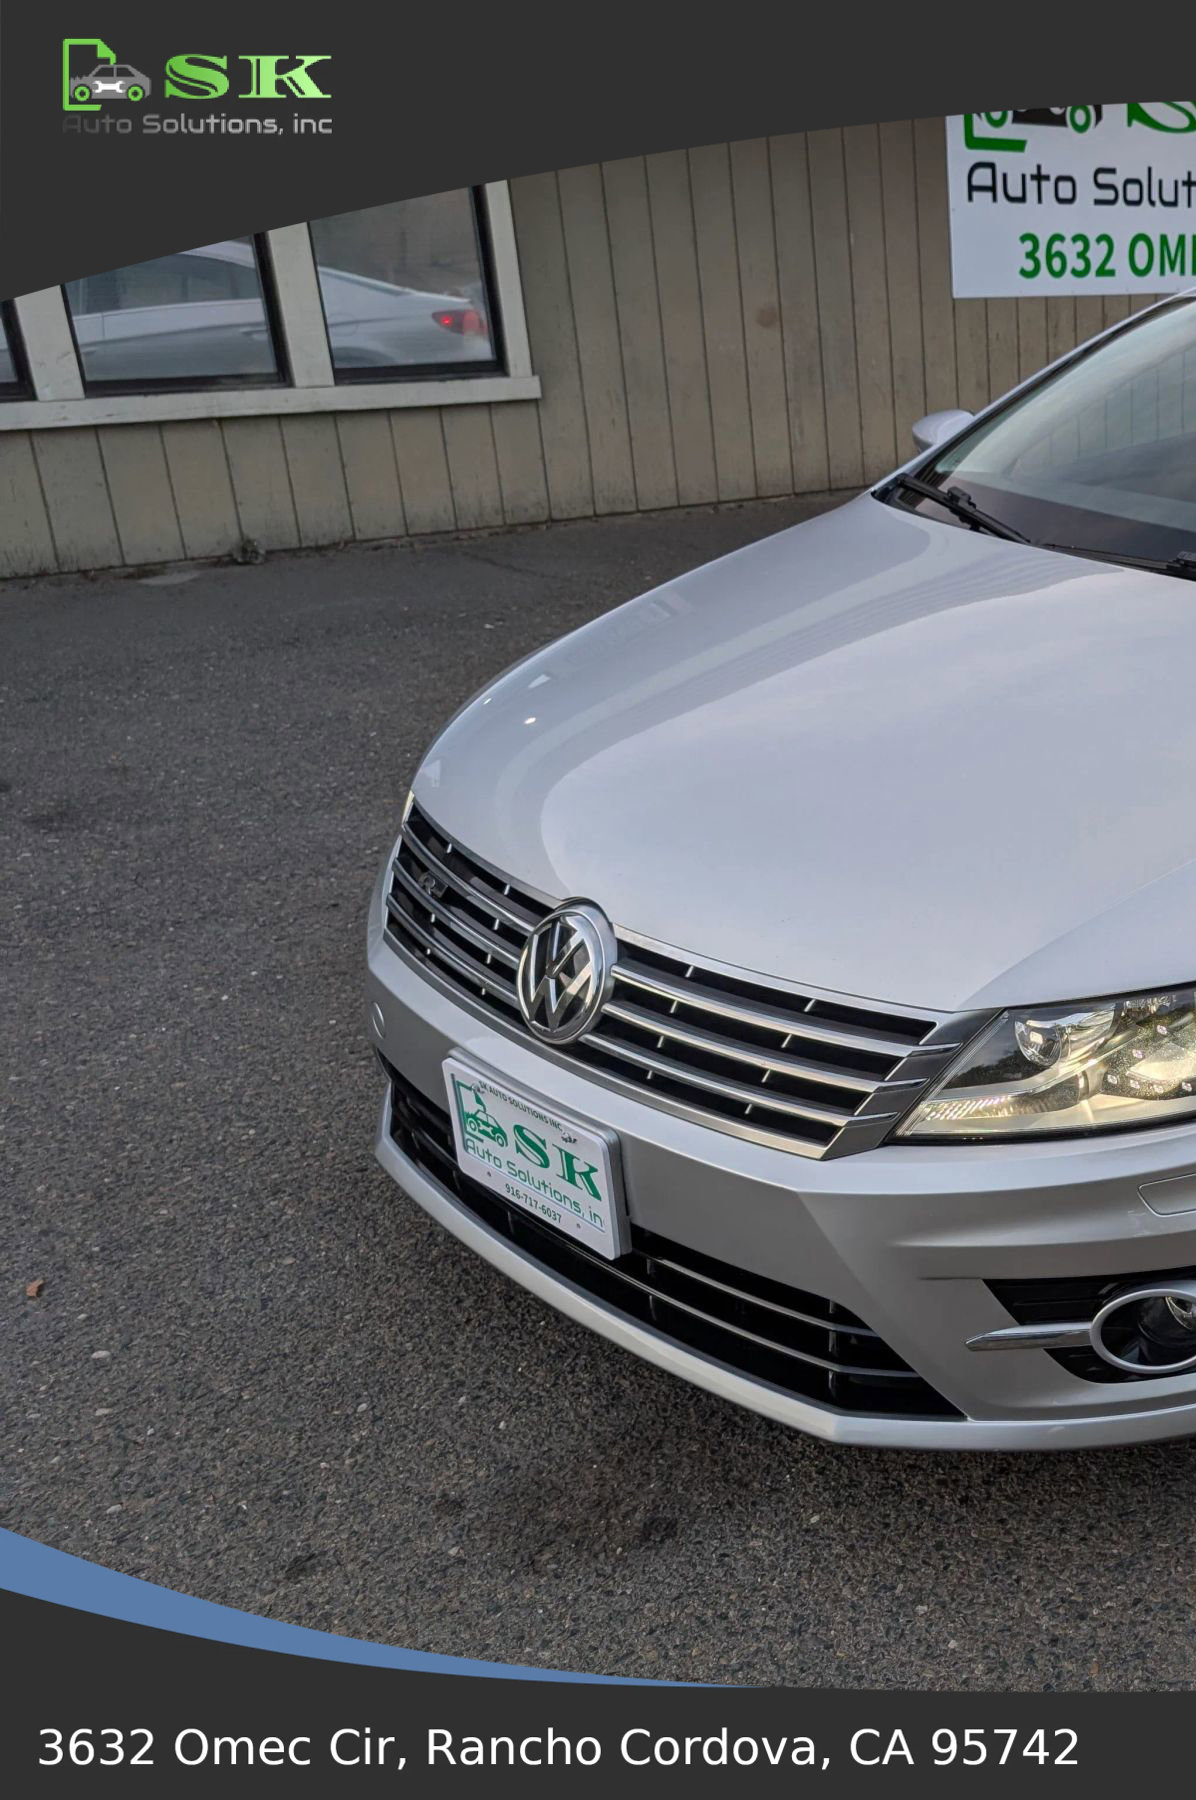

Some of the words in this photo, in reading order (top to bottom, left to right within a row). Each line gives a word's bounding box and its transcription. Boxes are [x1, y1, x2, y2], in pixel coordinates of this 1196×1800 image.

[967, 162, 1077, 205] Auto
[1018, 233, 1115, 278] 3632
[489, 1086, 508, 1102] AUTO
[508, 1096, 549, 1124] SOLUTIONS
[466, 1138, 503, 1169] Auto
[506, 1160, 585, 1218] Solutions,
[588, 1205, 606, 1228] in
[513, 1124, 602, 1202] SK
[505, 1183, 562, 1224] 916-717-6037
